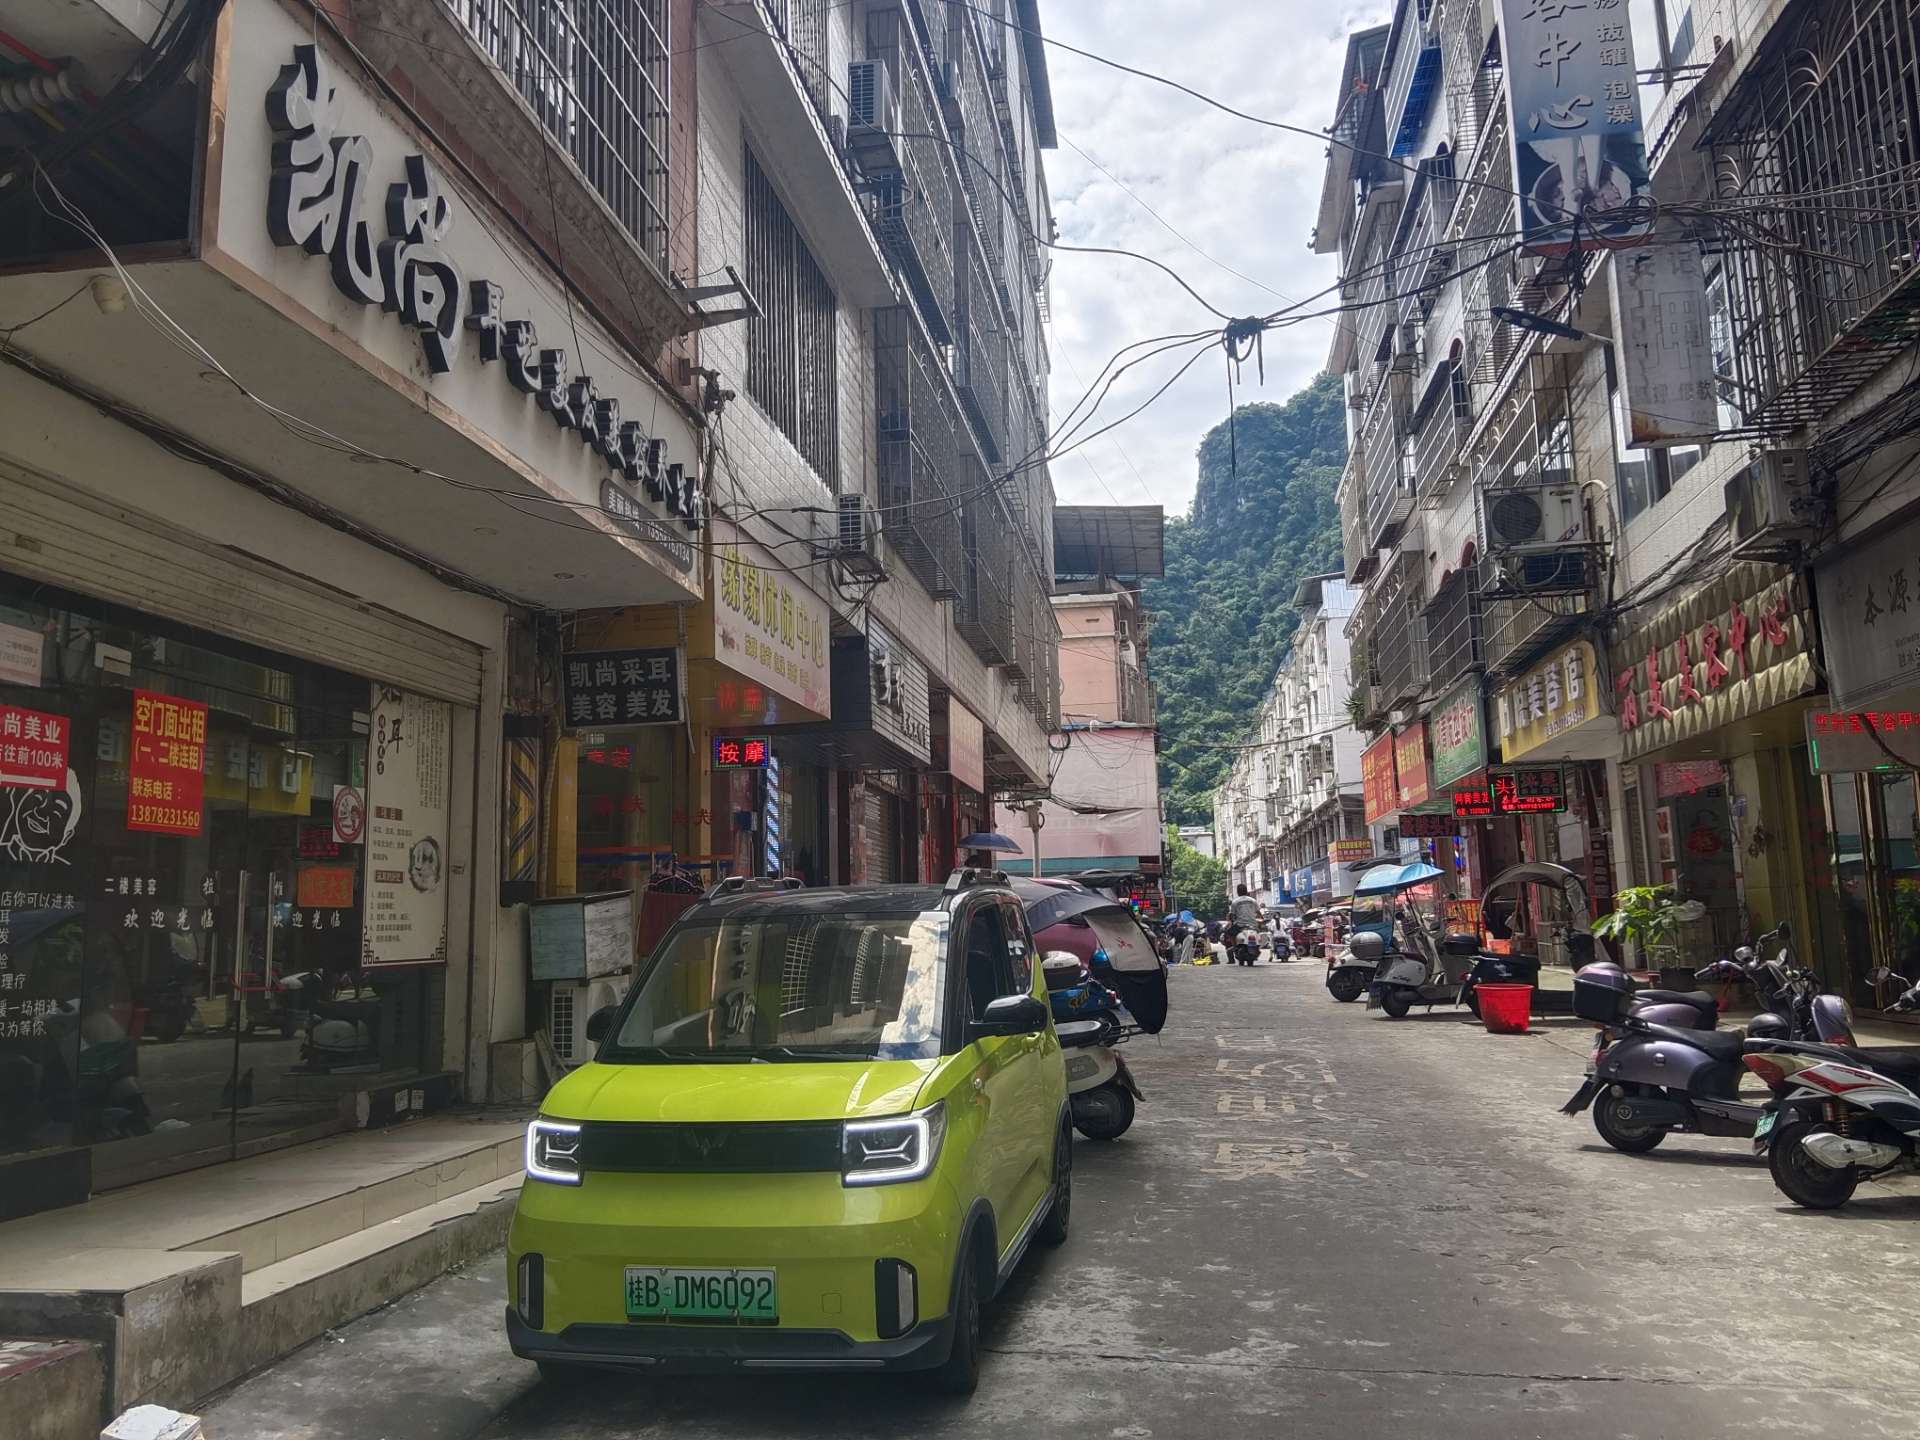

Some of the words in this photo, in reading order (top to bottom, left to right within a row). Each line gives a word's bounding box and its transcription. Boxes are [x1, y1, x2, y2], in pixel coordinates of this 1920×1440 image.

[266, 45, 463, 372] 凯尚
[570, 656, 672, 689] 凯尚采耳
[134, 697, 205, 744] 空门面出租
[0, 744, 63, 769] 往前100米
[719, 743, 765, 763] 按摩
[131, 804, 200, 829] 13878231560
[104, 877, 157, 896] 二楼美容
[202, 877, 215, 895] 拉
[123, 907, 214, 931] 欢迎光临
[272, 909, 341, 930] 欢迎光临
